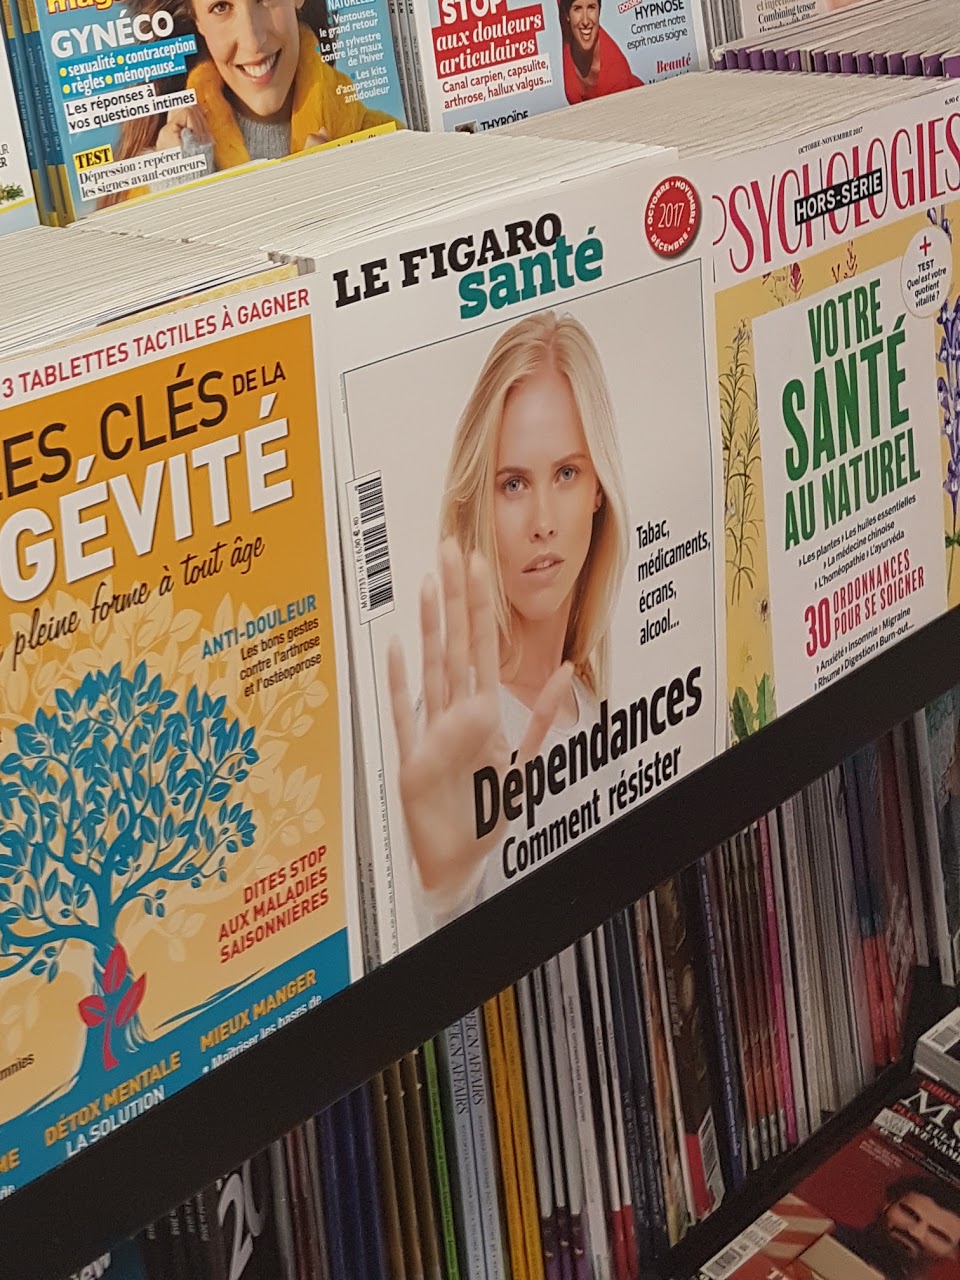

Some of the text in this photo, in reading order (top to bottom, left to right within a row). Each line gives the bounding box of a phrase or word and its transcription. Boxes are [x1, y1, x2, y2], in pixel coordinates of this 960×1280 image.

[50, 10, 174, 58] GYNÉCO
[436, 13, 542, 51] aux douleurs
[439, 39, 536, 74] articulaires
[658, 202, 685, 229] 2017
[795, 171, 882, 223] HORS-SÉRIE
[332, 212, 563, 309] LE FIGARO
[458, 226, 604, 320] santé
[19, 288, 310, 393] TABLETTES TACTILES À GAGNER
[807, 278, 883, 365] VOTRE
[100, 362, 229, 461] CLÉS
[232, 368, 258, 397] DE
[261, 361, 287, 386] LA
[782, 313, 909, 482] SANTÉ
[785, 427, 921, 551] AU NATUREL
[638, 529, 711, 582] médicaments,
[202, 594, 317, 660] ANTI-DOULEUR
[805, 549, 910, 657] 30 ORDONNANCES
[473, 666, 702, 839] Dépendances
[502, 745, 682, 880] Comment résister
[199, 969, 317, 1053] MIEUX MANGER
[44, 1051, 181, 1147] DÉTOX MENTALE
